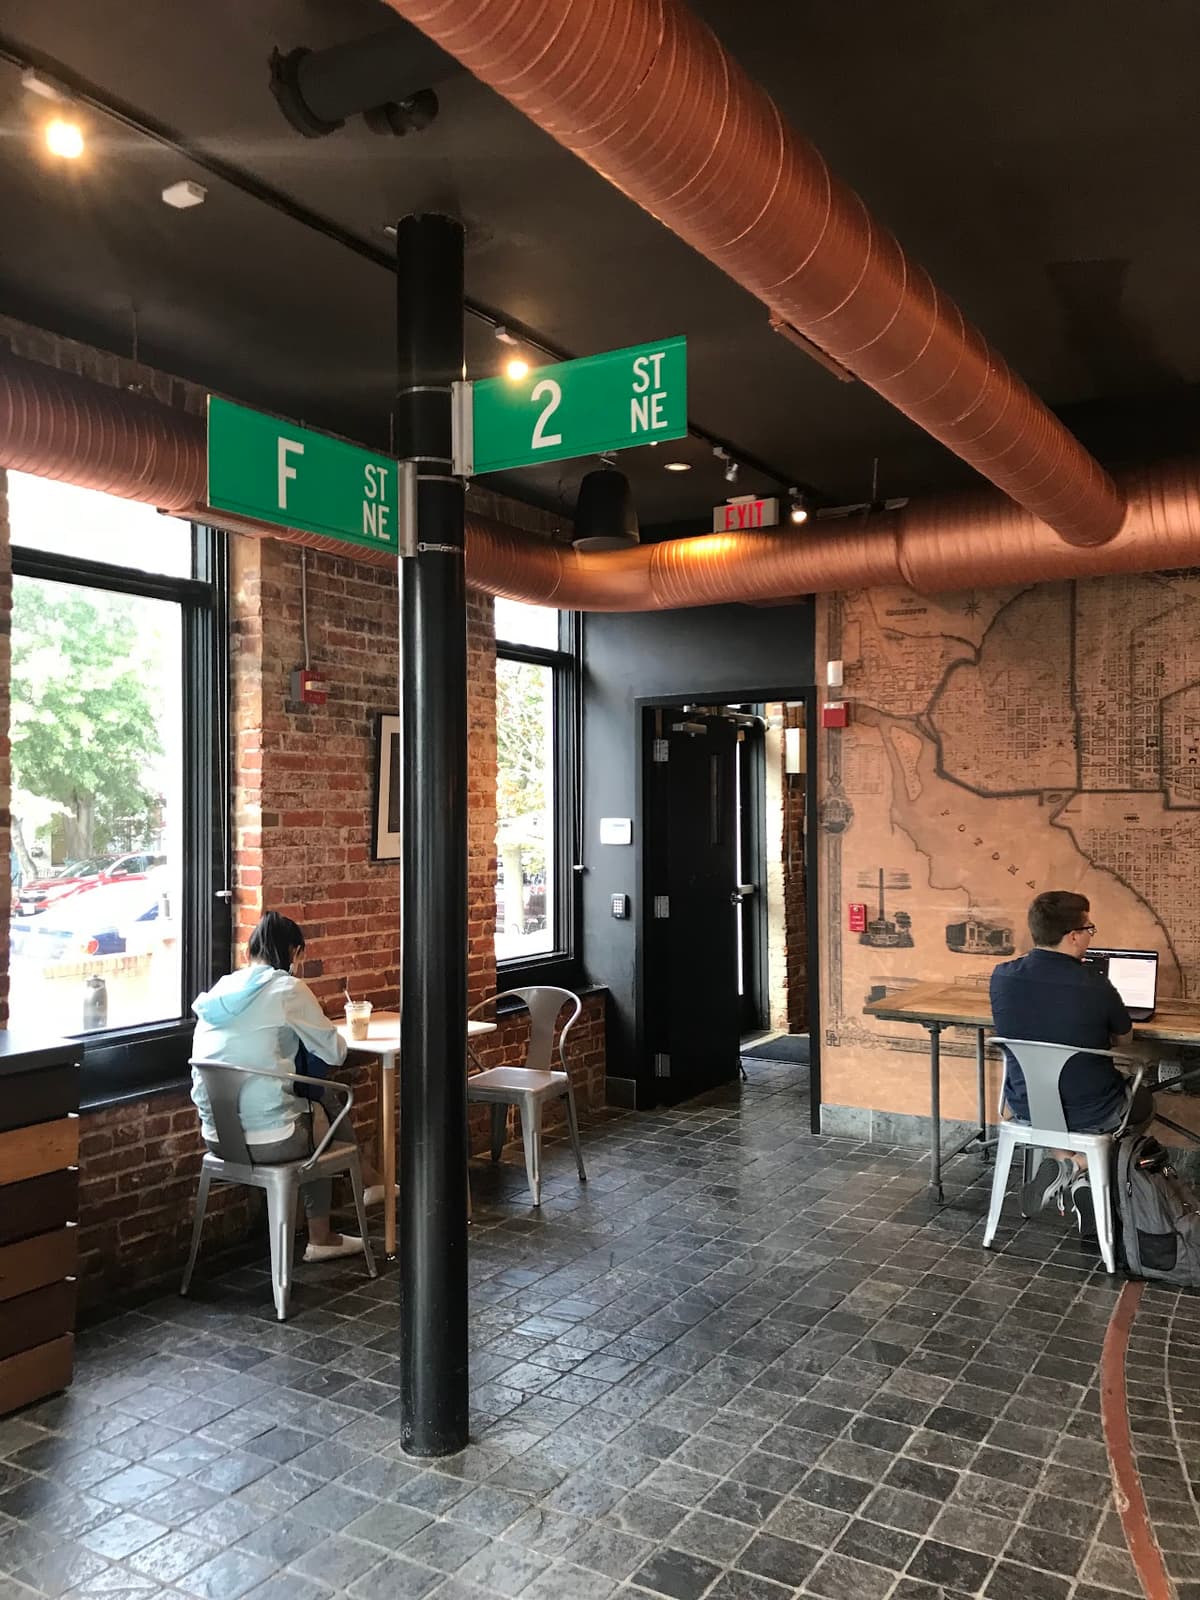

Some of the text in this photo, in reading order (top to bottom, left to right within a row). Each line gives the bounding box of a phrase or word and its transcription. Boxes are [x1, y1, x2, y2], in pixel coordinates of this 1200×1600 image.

[632, 353, 667, 393] ST
[530, 380, 562, 449] 2
[631, 392, 668, 433] NE
[277, 437, 305, 509] F
[364, 463, 389, 502] ST
[363, 501, 391, 540] NE
[724, 501, 765, 529] EXIT
